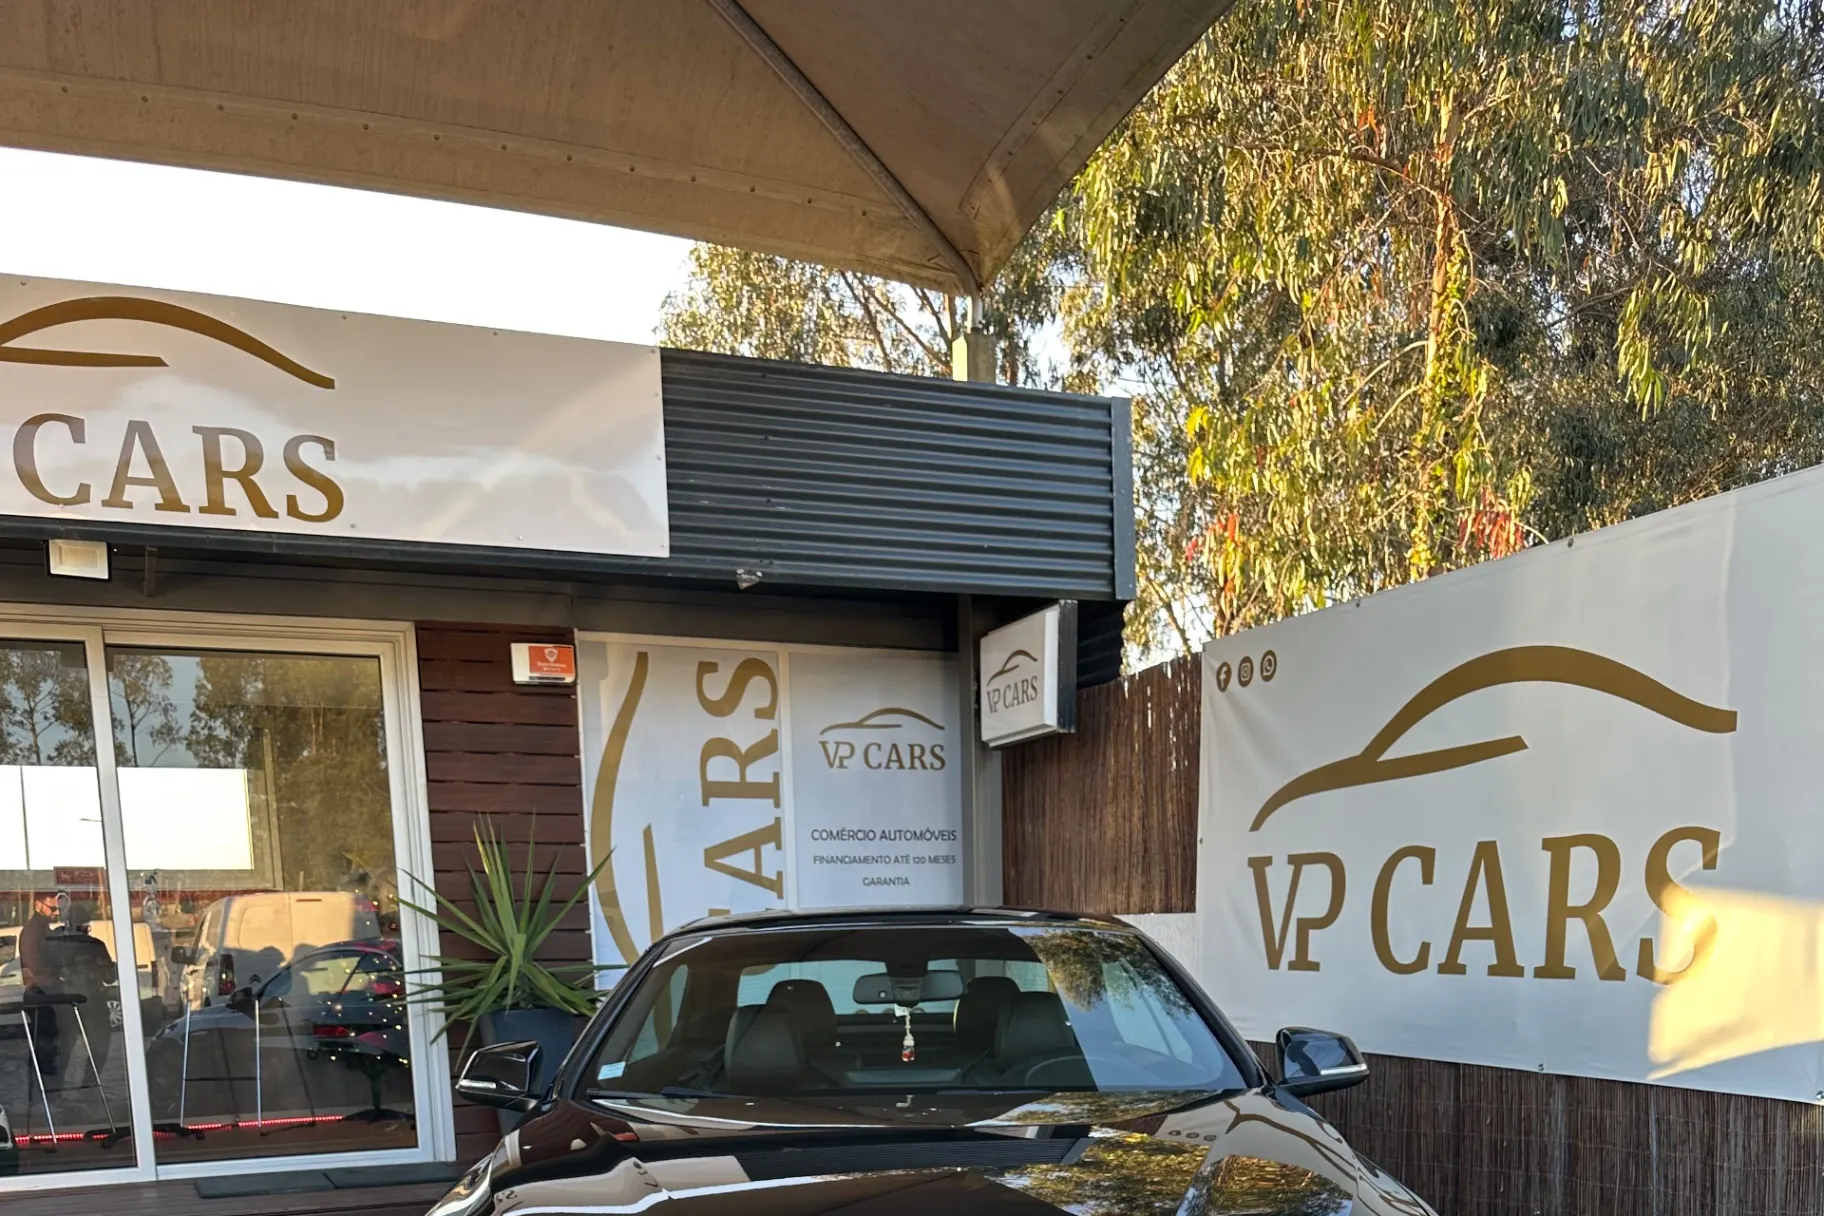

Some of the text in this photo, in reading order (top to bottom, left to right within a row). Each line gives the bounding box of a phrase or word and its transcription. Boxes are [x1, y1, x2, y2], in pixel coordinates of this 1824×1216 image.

[11, 412, 346, 523] CARS
[986, 675, 1039, 714] VP CARS
[818, 740, 947, 771] VP CARS
[695, 656, 784, 917] ARS
[810, 826, 957, 842] COMÉRCIO AUTOMÓVEIS
[812, 853, 956, 865] FINANCIAMENTO ATÉ 120 MESES
[862, 876, 910, 887] GARANTIA
[1246, 825, 1723, 987] VP CARS
